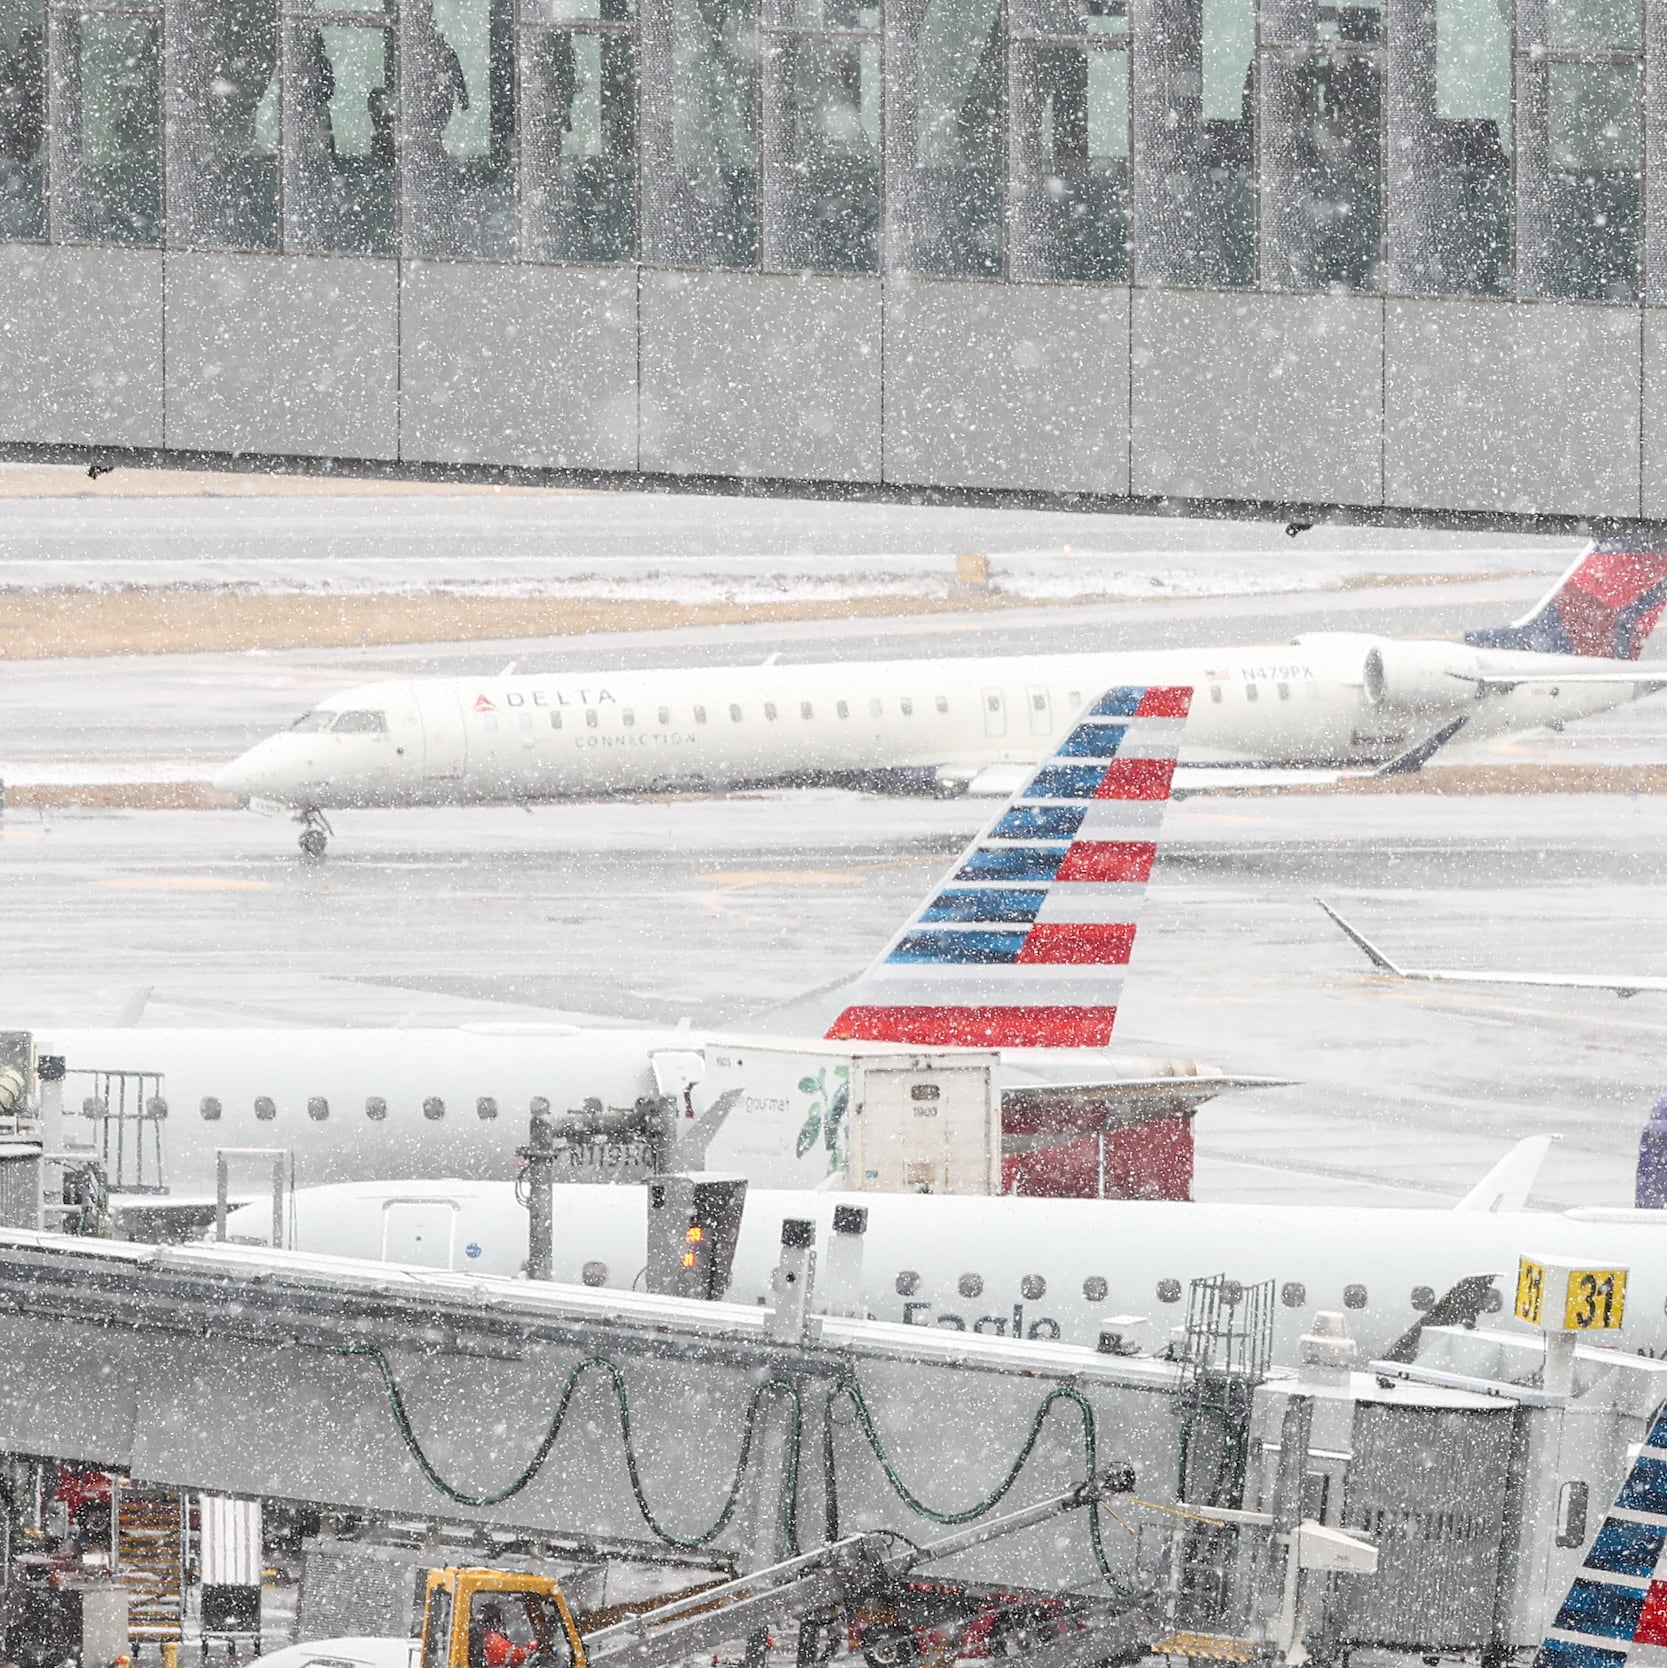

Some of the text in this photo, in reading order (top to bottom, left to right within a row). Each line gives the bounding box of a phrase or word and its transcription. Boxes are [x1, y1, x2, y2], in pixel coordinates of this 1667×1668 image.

[507, 689, 617, 708] DELTA
[574, 732, 695, 748] CONNECTION
[1575, 1273, 1616, 1328] 31
